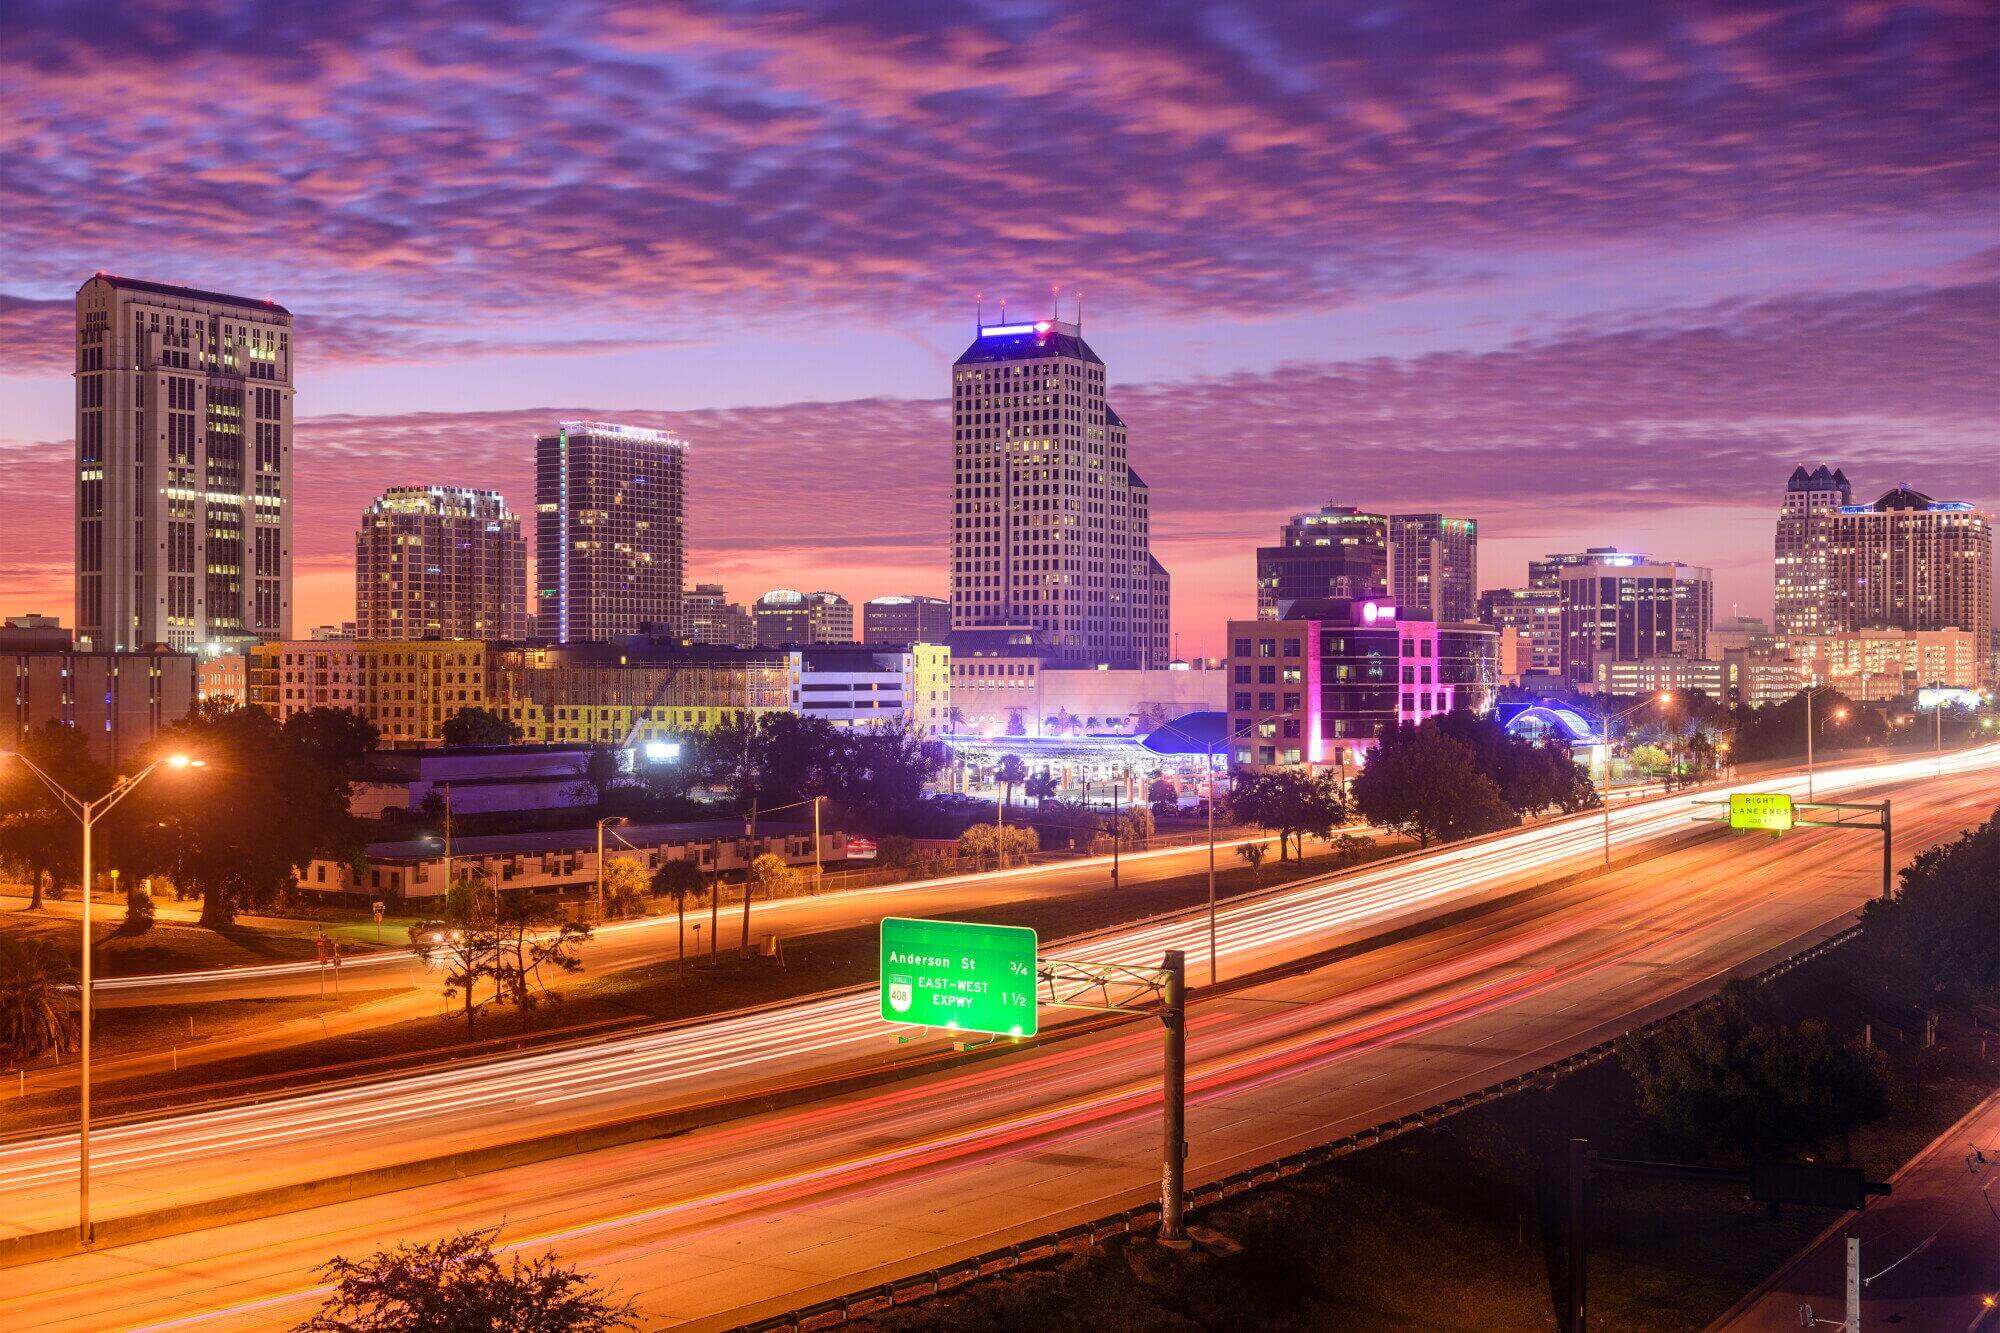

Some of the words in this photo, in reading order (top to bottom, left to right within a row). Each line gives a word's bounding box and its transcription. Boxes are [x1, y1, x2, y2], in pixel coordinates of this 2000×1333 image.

[888, 950, 950, 968] Anderson
[961, 957, 976, 970] St
[1010, 961, 1028, 976] 3/4
[918, 976, 989, 993] EAST-WEST
[891, 990, 907, 1001] 408
[933, 994, 973, 1008] EXPWY
